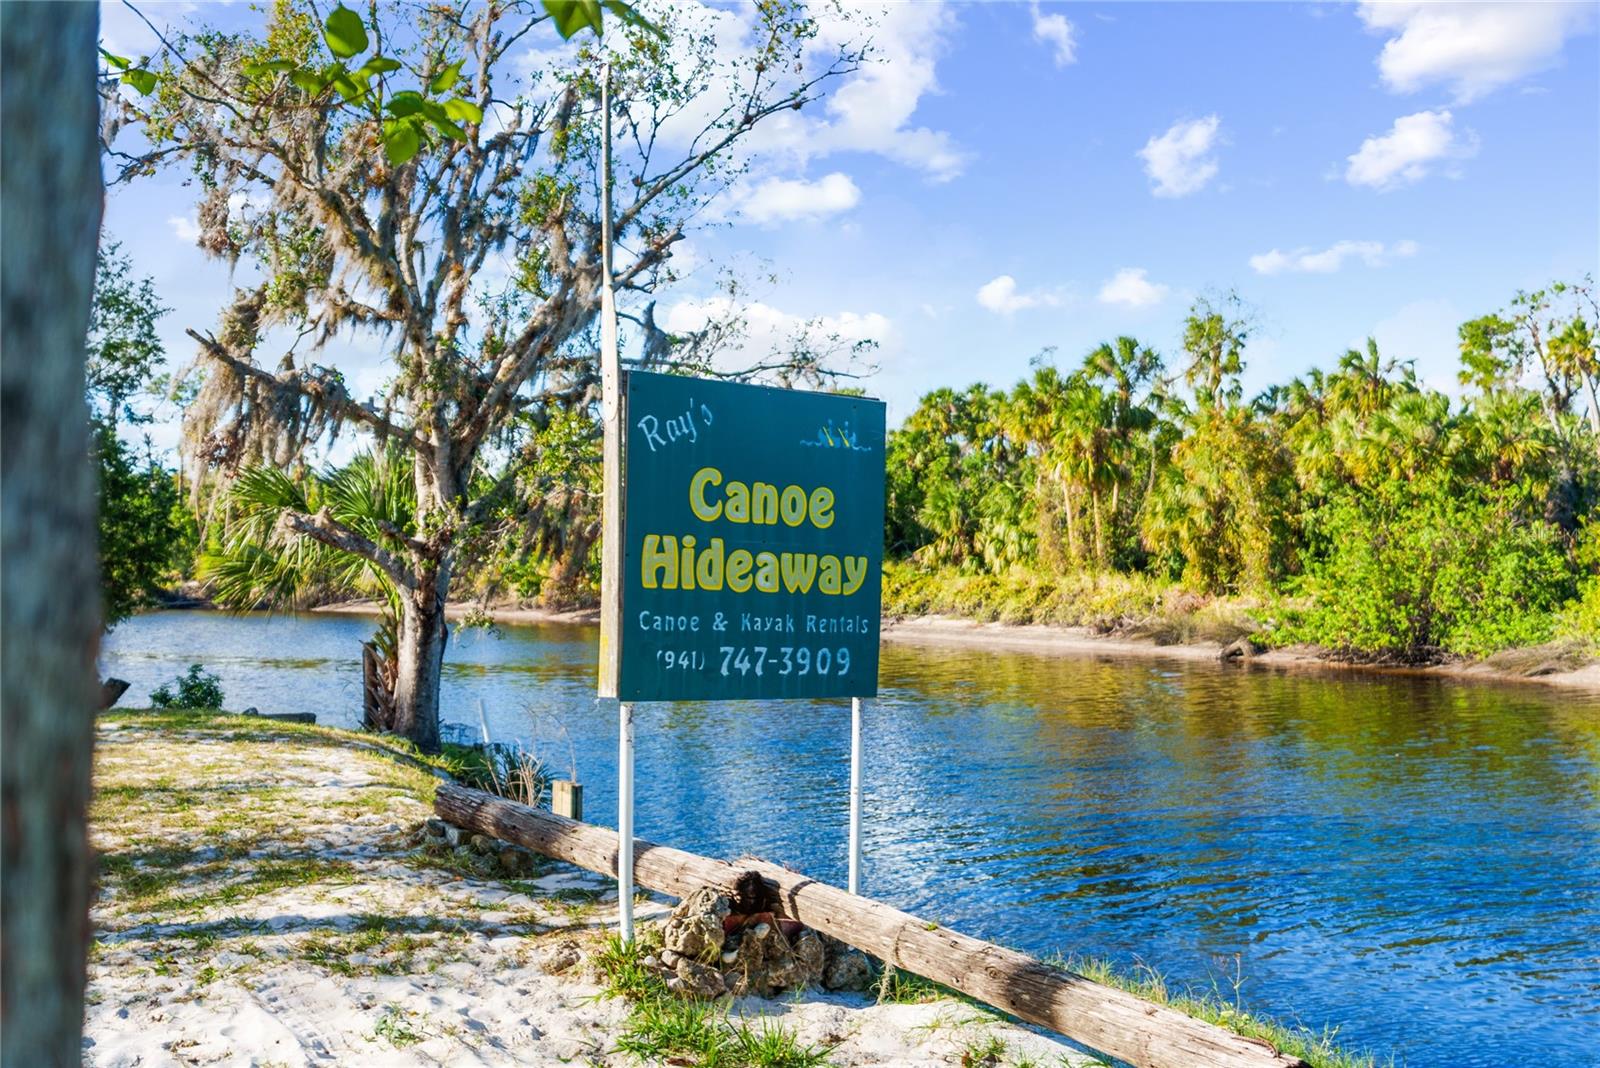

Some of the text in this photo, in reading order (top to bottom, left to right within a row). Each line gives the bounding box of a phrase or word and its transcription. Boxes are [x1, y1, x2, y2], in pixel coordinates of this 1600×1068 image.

[637, 398, 713, 452] Ray's
[689, 467, 835, 529] Canoe
[641, 534, 868, 596] Hideaway
[639, 610, 869, 634] Canoe & Kayak Rentals
[656, 646, 850, 676] (941) 747-3909
